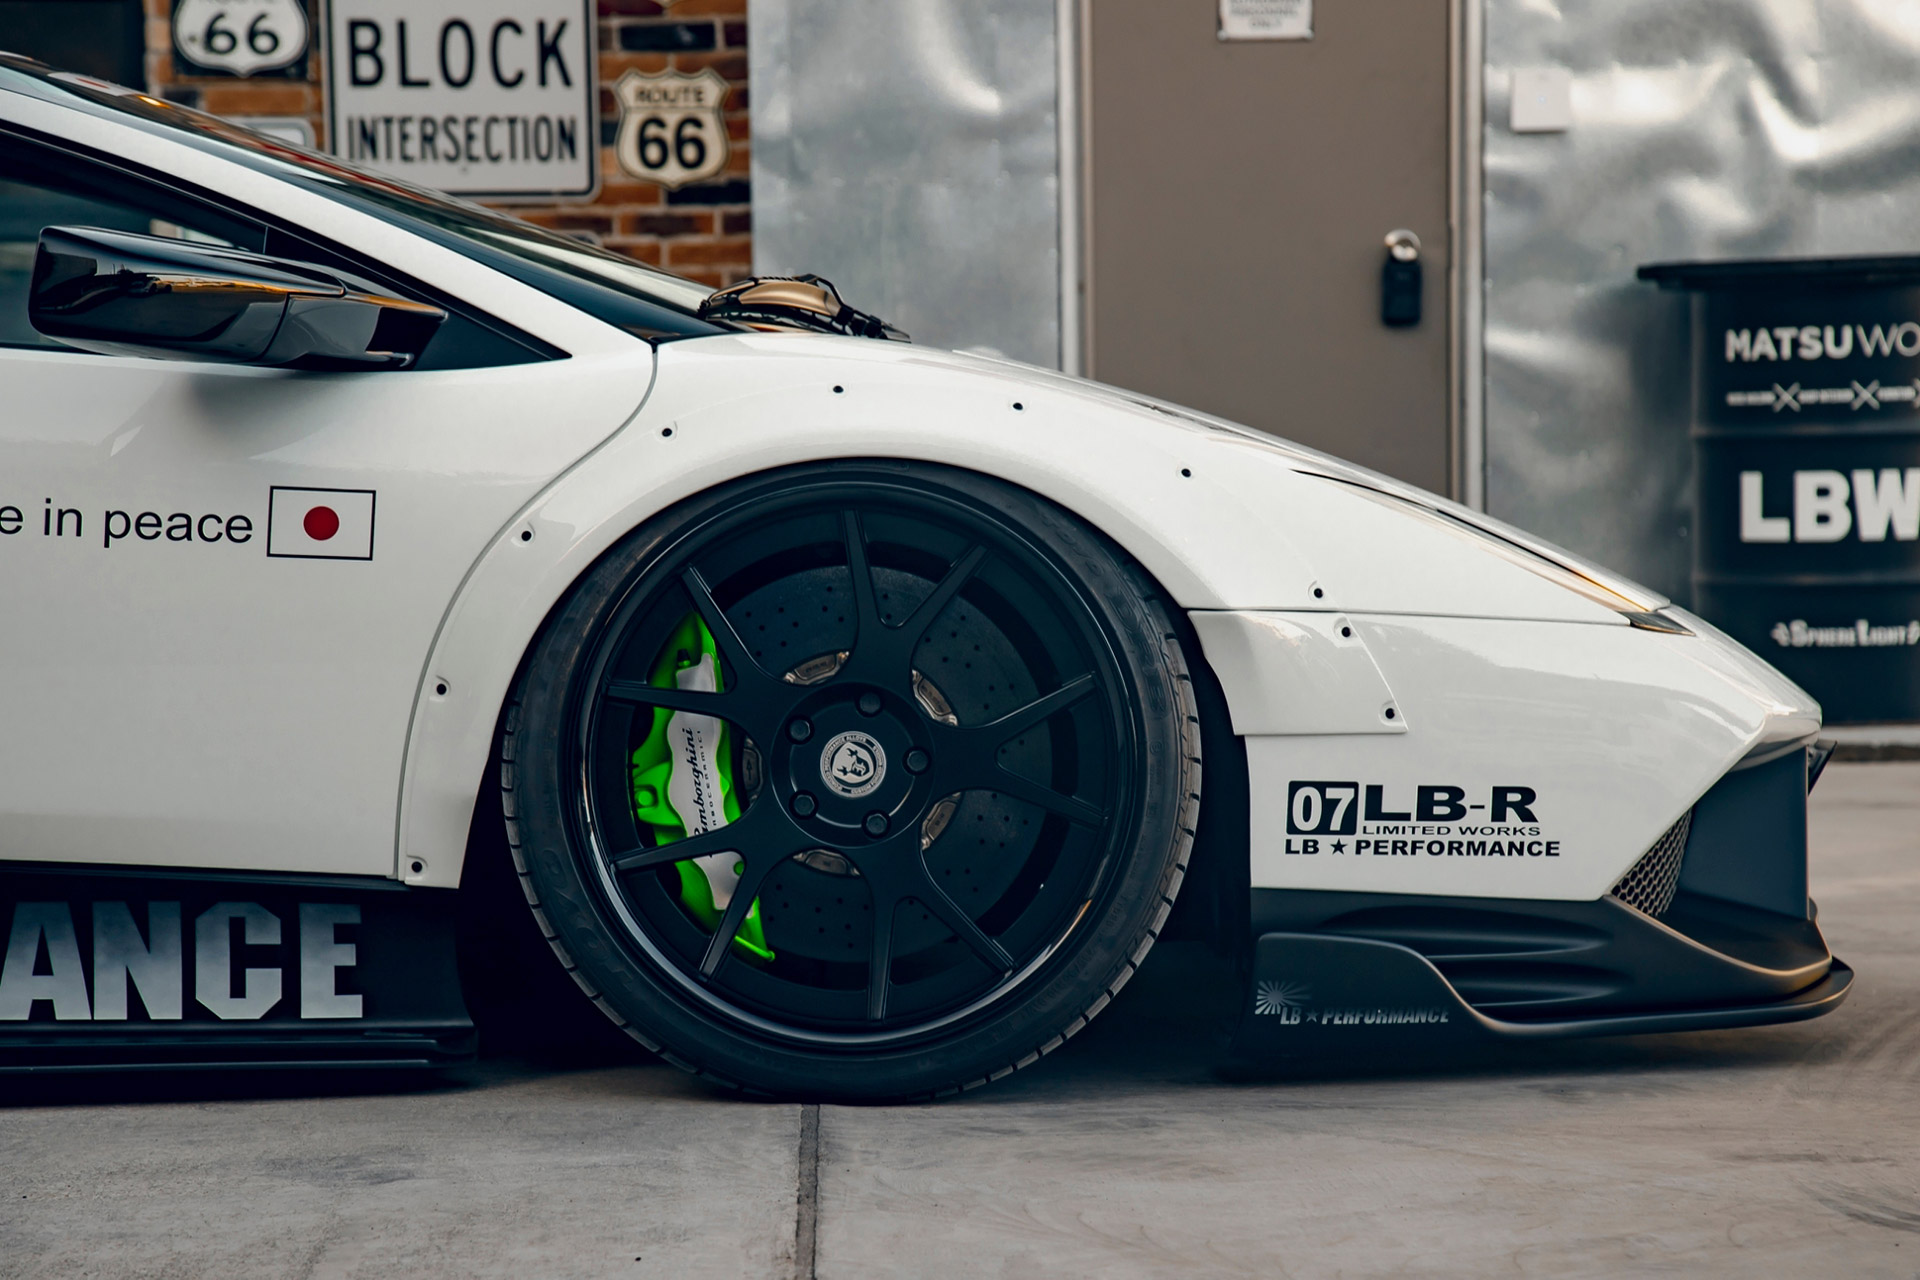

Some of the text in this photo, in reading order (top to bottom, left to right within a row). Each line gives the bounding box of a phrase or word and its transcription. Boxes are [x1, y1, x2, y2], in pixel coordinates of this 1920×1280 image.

[203, 12, 279, 55] 66
[347, 19, 573, 88] BLOCK
[635, 85, 705, 103] ROUTE
[348, 116, 577, 163] INTERSECTION
[638, 115, 706, 170] 66
[44, 498, 83, 537] in
[103, 510, 253, 549] peace
[1739, 468, 1920, 543] LBW
[1291, 784, 1539, 832] 07 LB-R
[1362, 825, 1541, 837] LIMITED WORKS
[1284, 838, 1561, 857] LB PERFORMANCE
[0, 901, 363, 1020] ANCE
[1280, 1005, 1449, 1025] LB PERFORMANCE
